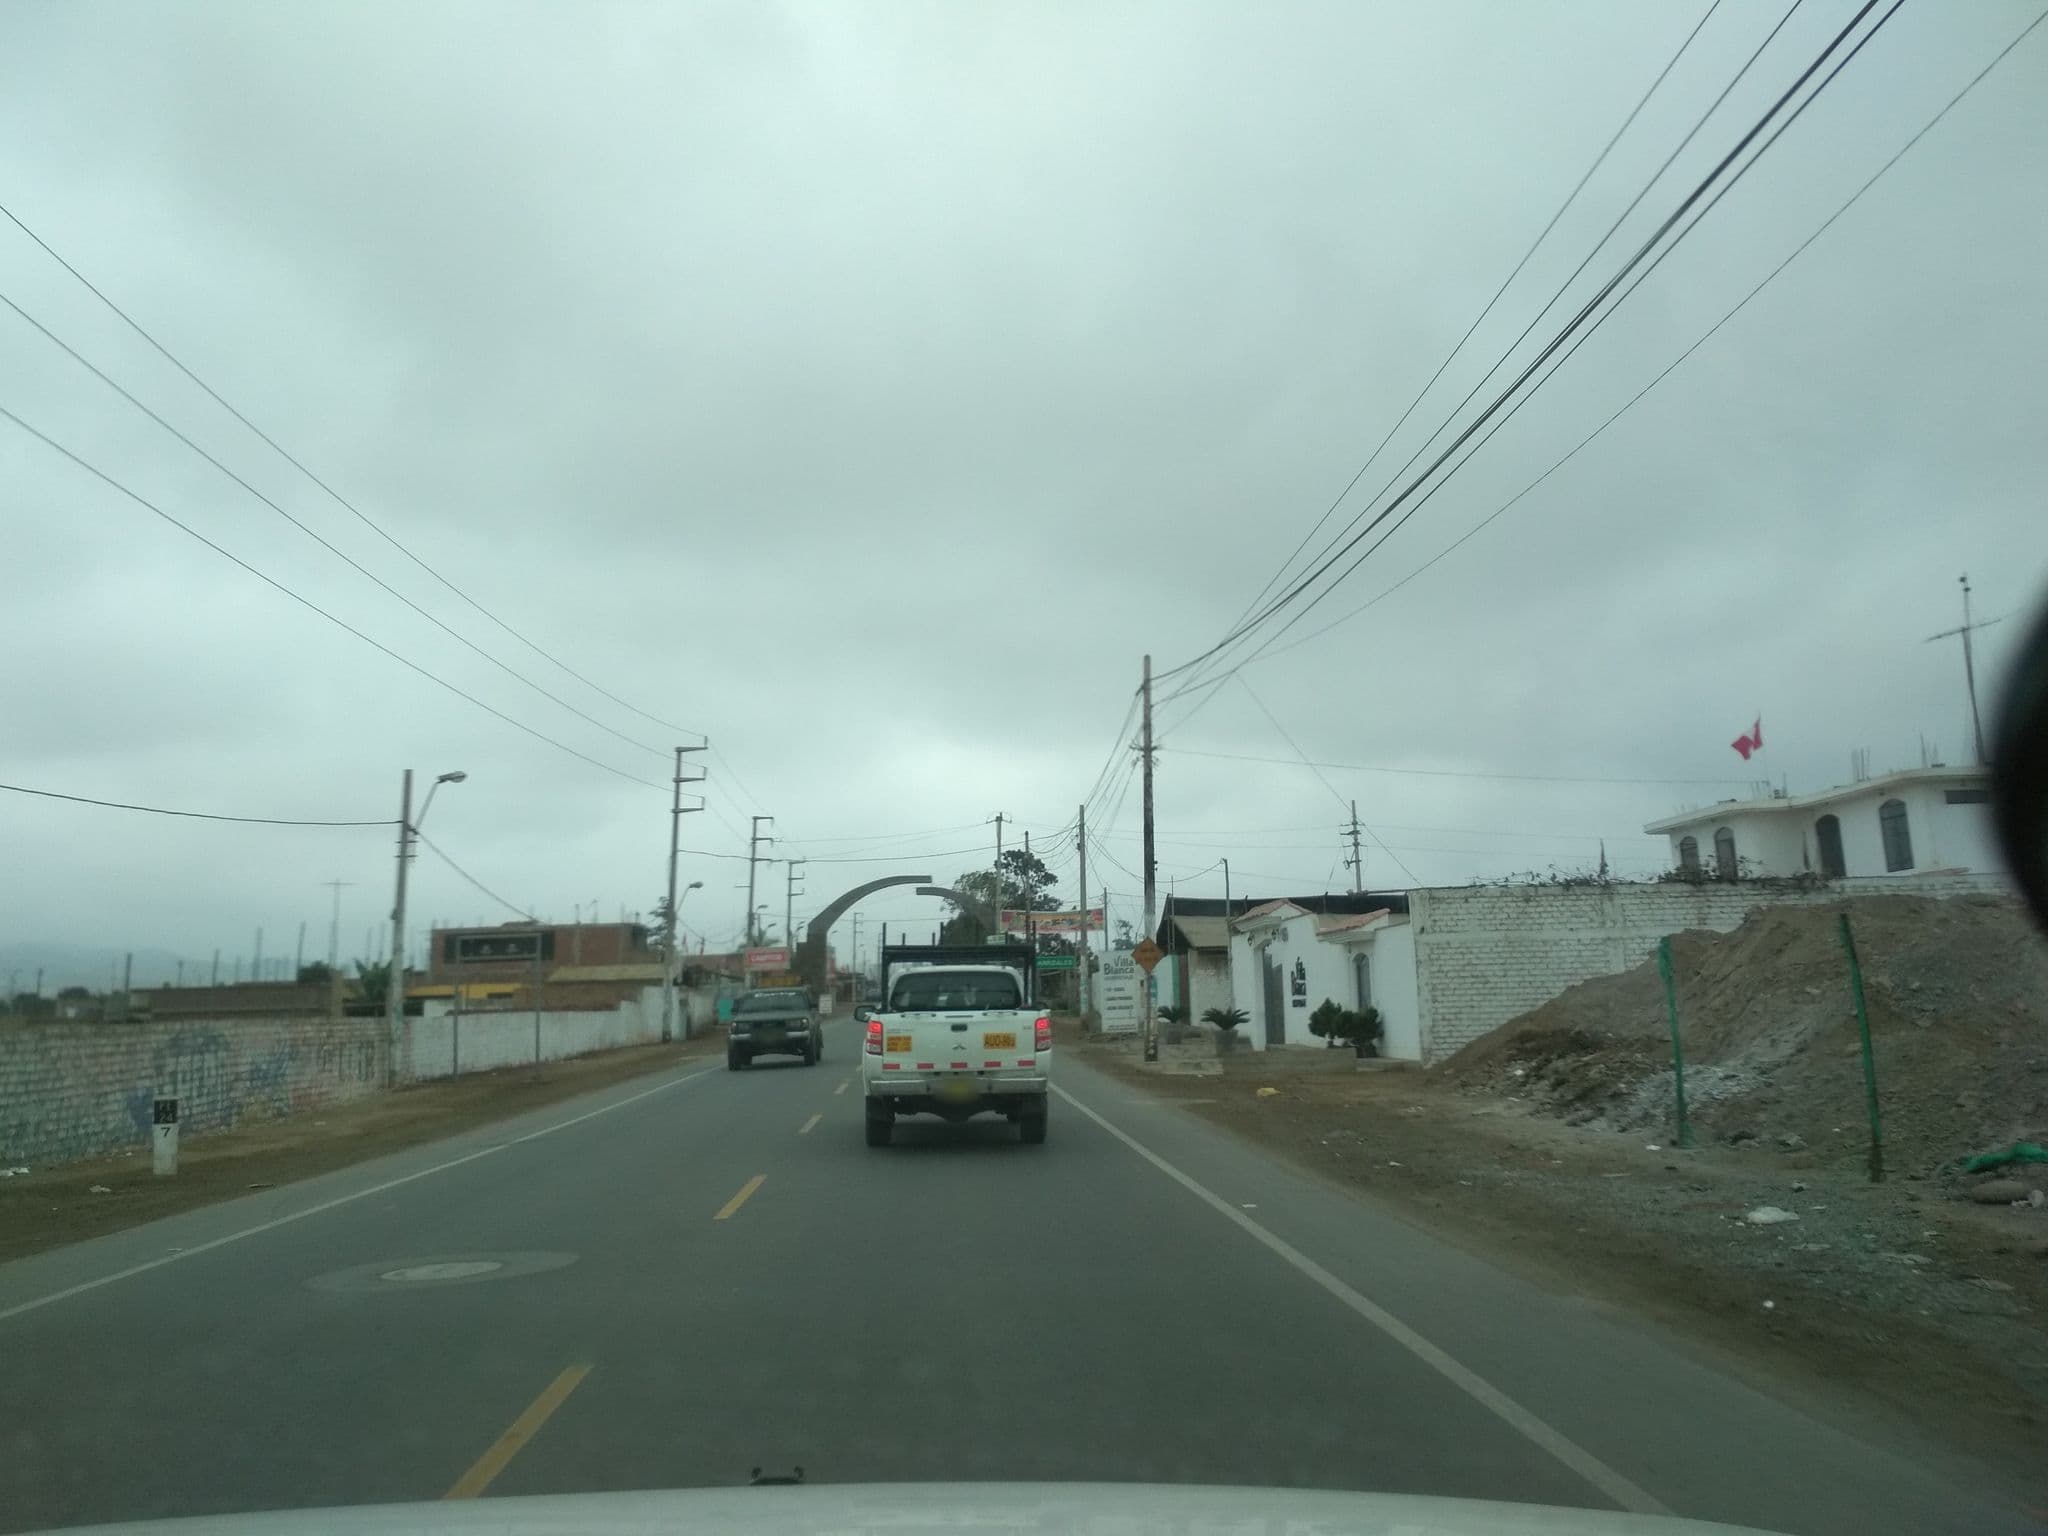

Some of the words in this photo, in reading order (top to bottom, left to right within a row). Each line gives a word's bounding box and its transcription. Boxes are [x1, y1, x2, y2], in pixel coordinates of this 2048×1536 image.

[1114, 955, 1135, 967] Villa
[1104, 963, 1135, 975] Blanca
[160, 1127, 170, 1137] 7
